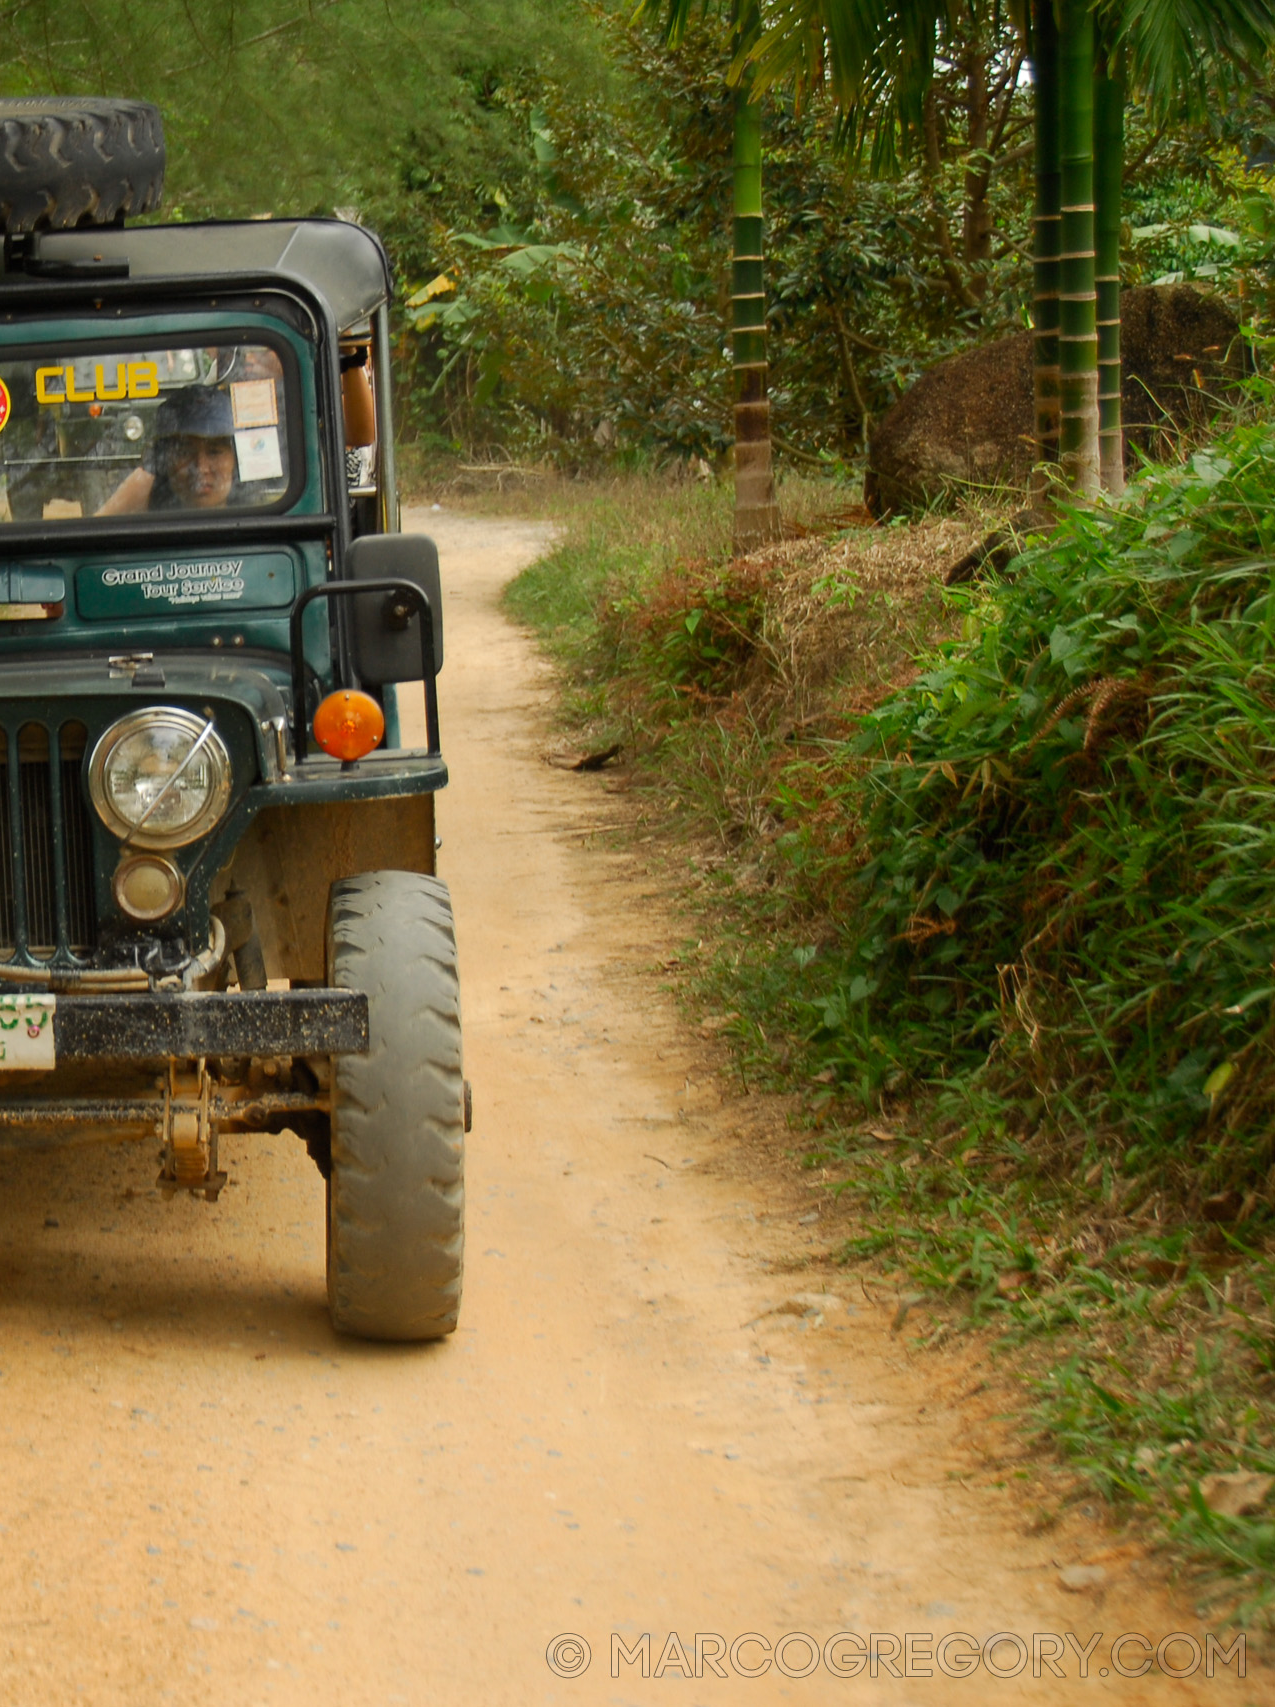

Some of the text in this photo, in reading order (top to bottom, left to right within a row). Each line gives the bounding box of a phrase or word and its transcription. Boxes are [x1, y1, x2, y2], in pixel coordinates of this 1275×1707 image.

[36, 361, 160, 404] CLUB
[102, 560, 243, 586] Grand Journey
[141, 582, 178, 599] Tour
[181, 577, 245, 595] Service
